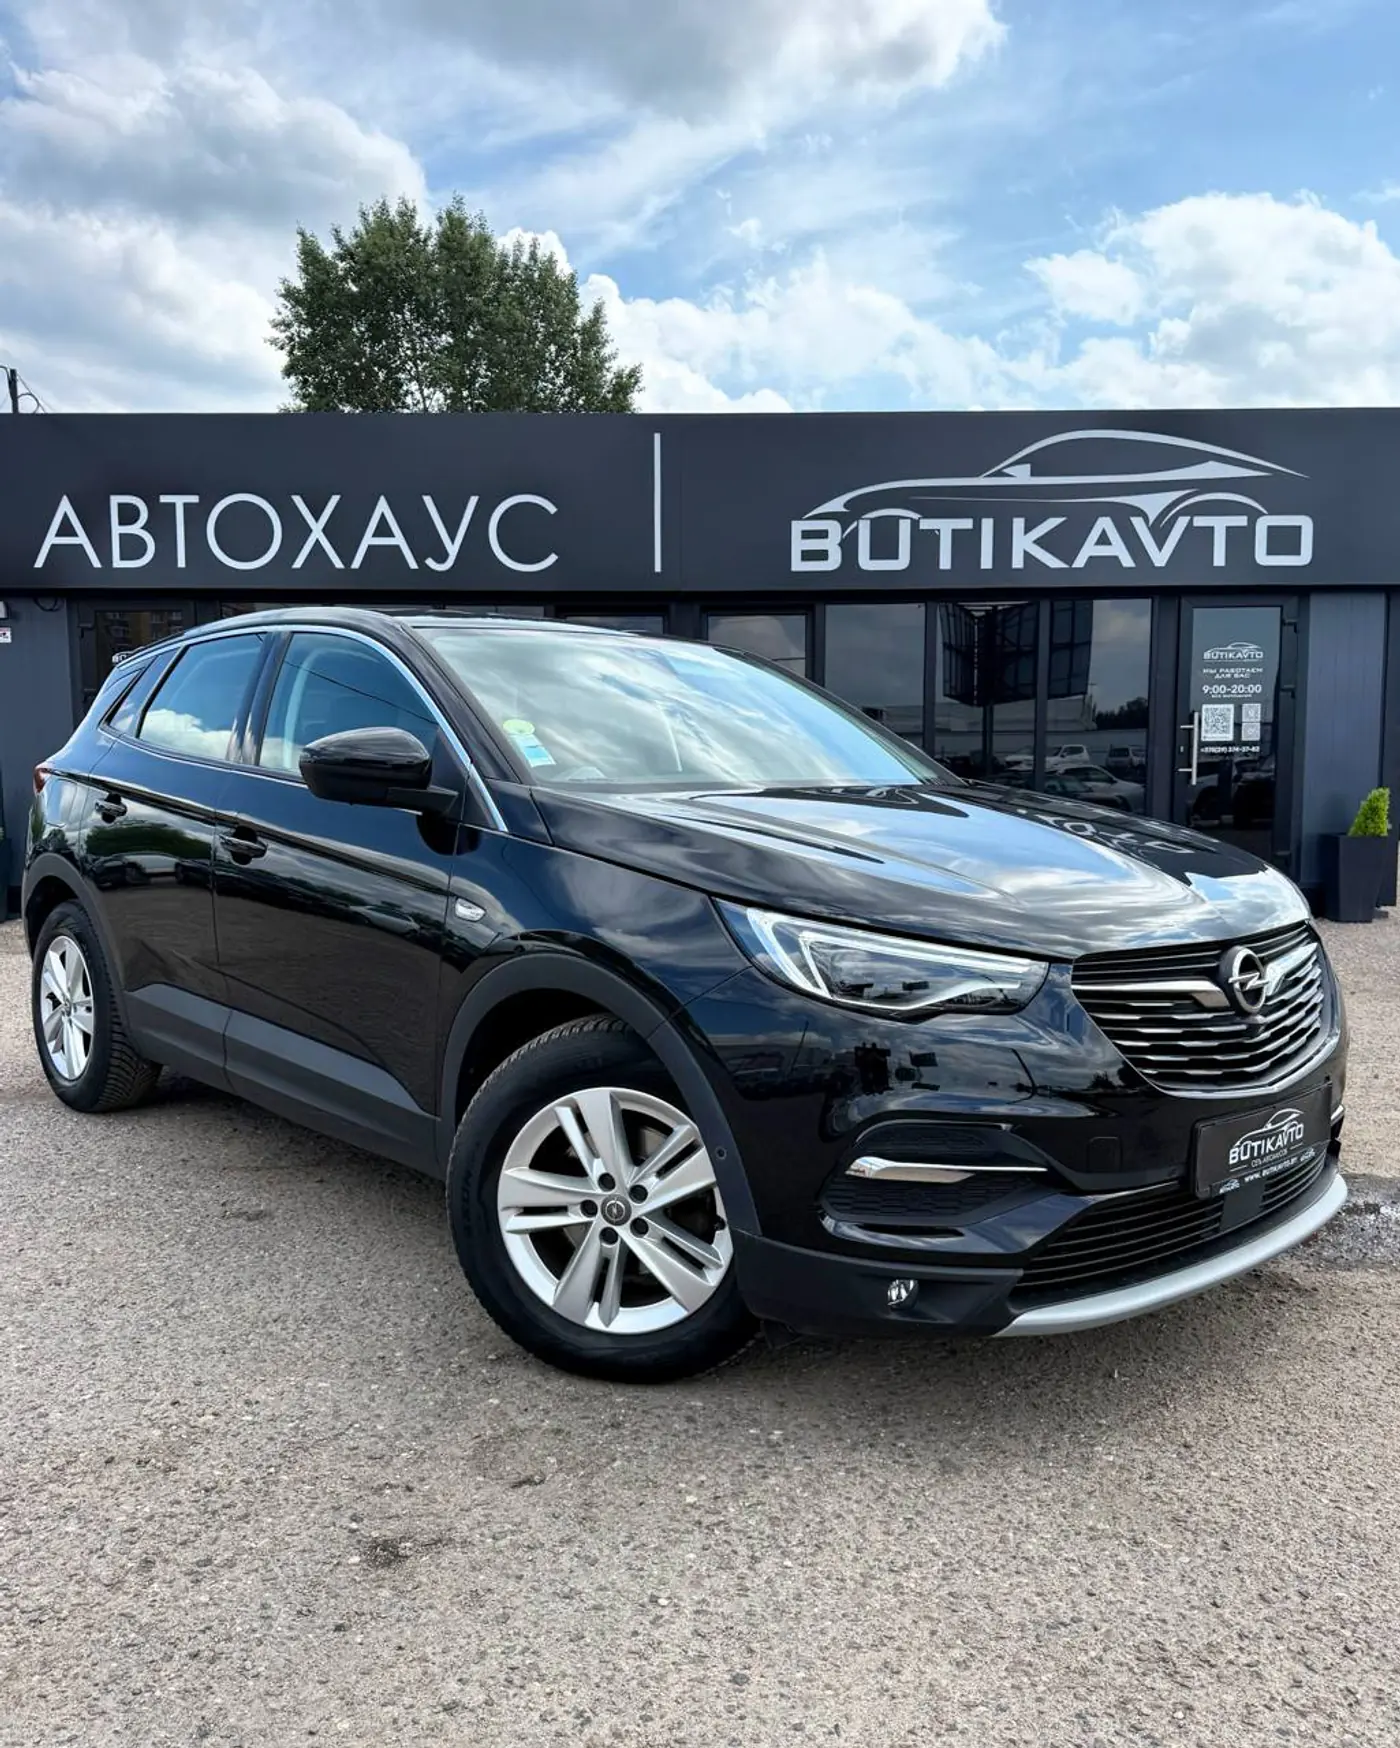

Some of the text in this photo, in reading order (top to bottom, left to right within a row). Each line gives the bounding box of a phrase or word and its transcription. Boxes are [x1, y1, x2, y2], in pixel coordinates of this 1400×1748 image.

[33, 493, 560, 572] АВТОХАУС
[790, 513, 1314, 573] BUTIKAVTO
[1203, 651, 1263, 659] BUTIKAVTO
[1202, 684, 1262, 694] 9:00-20:00
[1229, 1124, 1304, 1164] BUTIKAVTO
